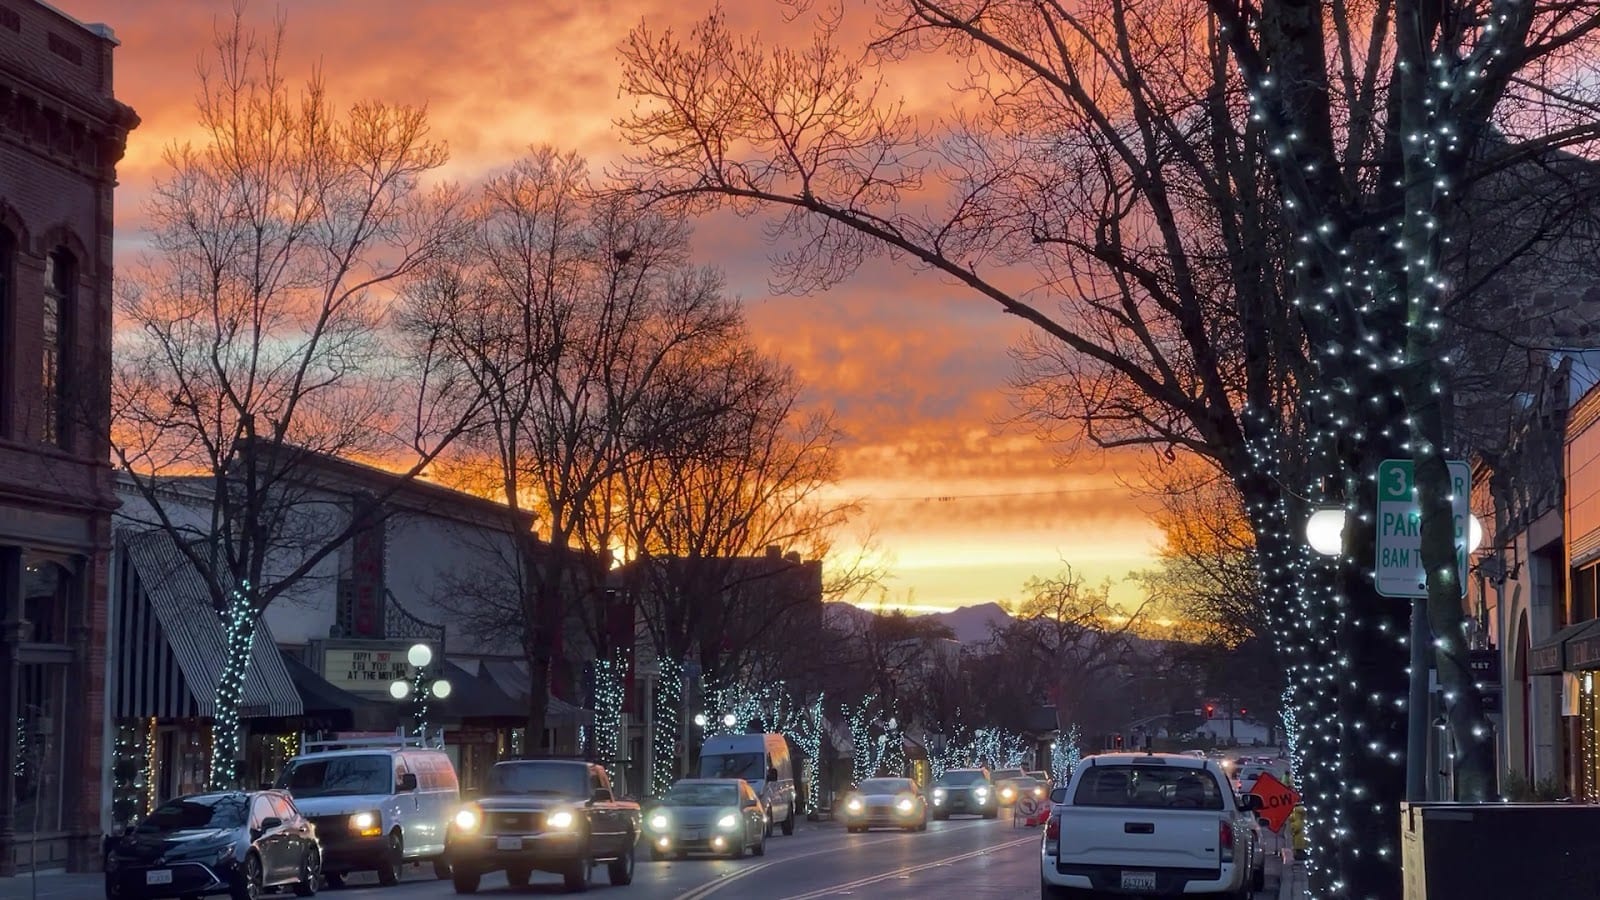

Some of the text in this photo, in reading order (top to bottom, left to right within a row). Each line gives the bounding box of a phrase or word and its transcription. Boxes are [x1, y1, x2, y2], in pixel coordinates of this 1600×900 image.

[1387, 467, 1407, 496] 3
[1383, 512, 1464, 538] PARG
[1382, 547, 1410, 569] 8AM
